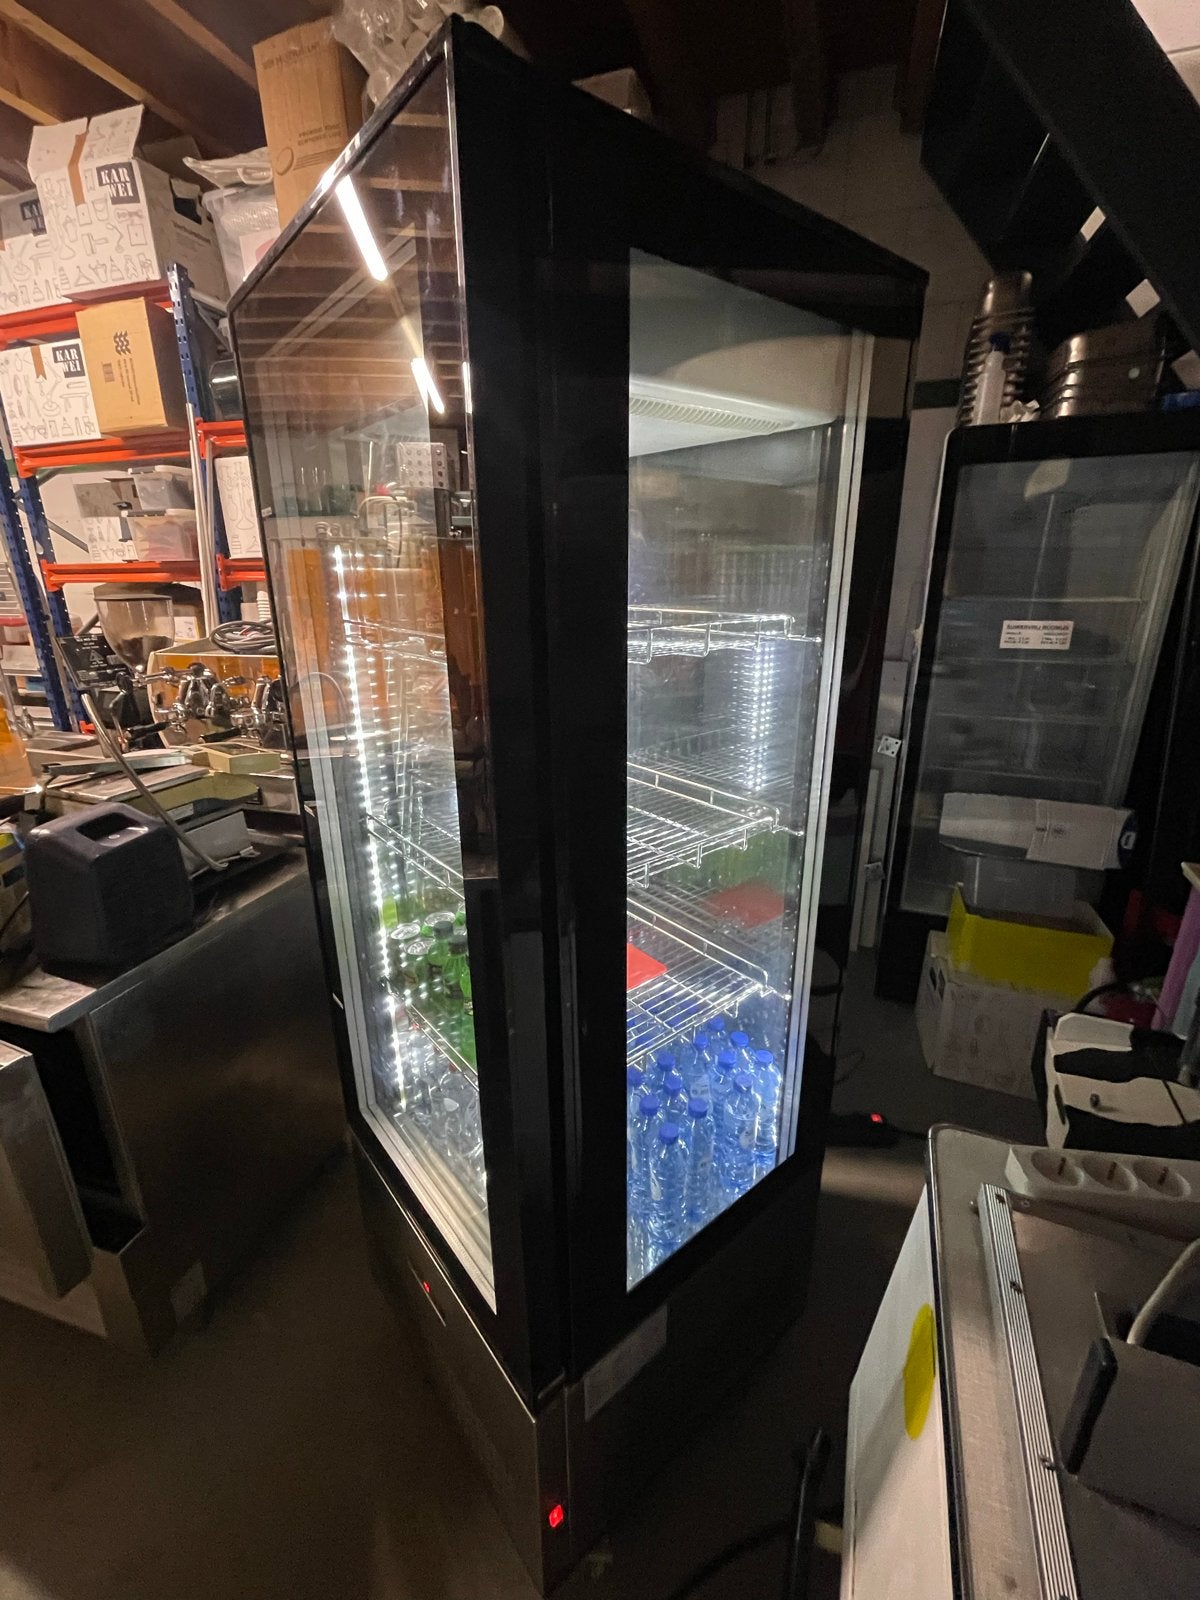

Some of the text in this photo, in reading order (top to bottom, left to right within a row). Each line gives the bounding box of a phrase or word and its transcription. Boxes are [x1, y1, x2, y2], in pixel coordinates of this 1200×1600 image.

[100, 167, 131, 185] KAR
[108, 182, 134, 198] WEI
[55, 348, 79, 362] KAR
[62, 359, 81, 373] WEI
